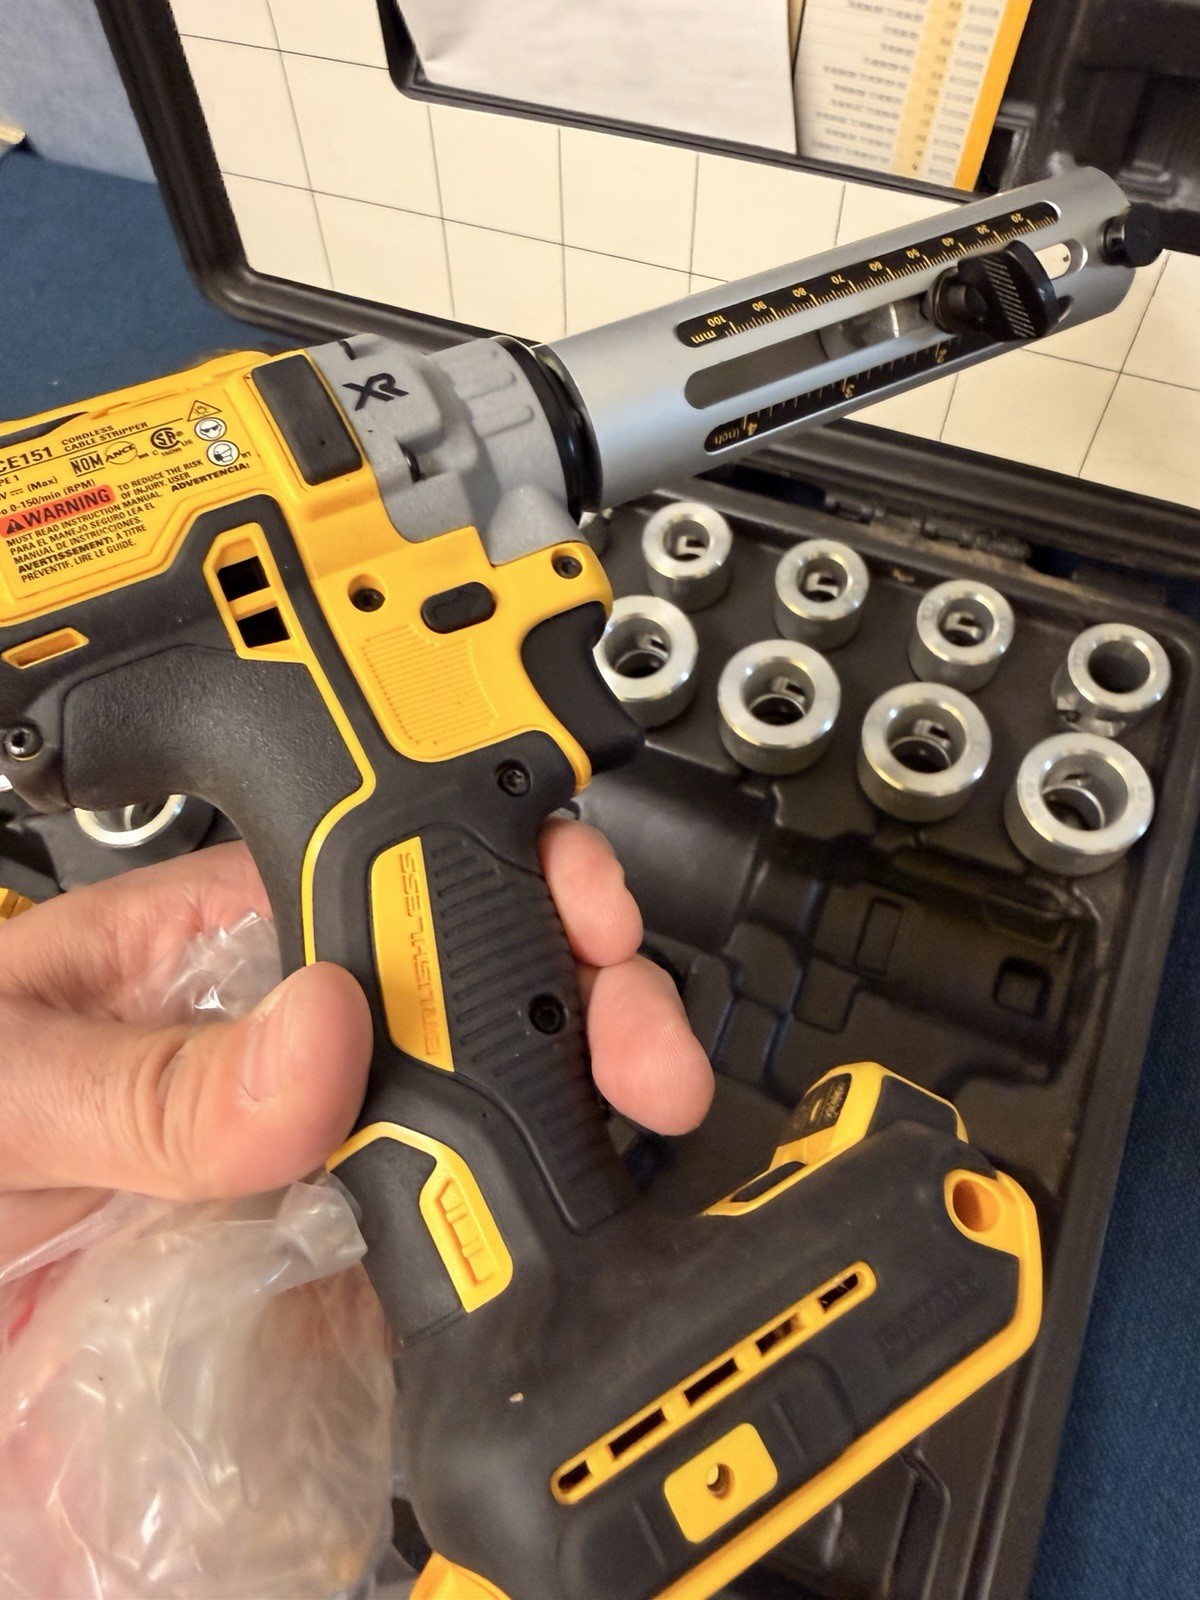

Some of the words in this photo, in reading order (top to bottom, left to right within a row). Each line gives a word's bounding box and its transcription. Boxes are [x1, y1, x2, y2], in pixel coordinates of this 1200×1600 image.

[831, 274, 846, 285] 70
[792, 287, 807, 298] 80
[752, 300, 768, 312] 90
[707, 315, 727, 327] 100
[690, 329, 717, 344] mm
[342, 372, 409, 411] XR
[61, 425, 114, 446] CORDLESS
[64, 439, 96, 452] CABLE
[99, 421, 149, 441] STRIPPER
[70, 453, 104, 474] NOM
[27, 475, 58, 492] (Max)
[117, 482, 130, 492] TO
[130, 472, 165, 488] REDUCE
[165, 465, 184, 476] THE
[183, 459, 204, 470] RISK
[121, 490, 132, 500] OF
[167, 471, 191, 484] USER
[171, 462, 250, 492] ADVERTENCIA:
[10, 491, 62, 512] 0-150/min
[63, 478, 96, 496] (RPM)
[21, 488, 111, 527] WARNING
[6, 532, 33, 547] MUST
[34, 524, 60, 538] READ
[60, 503, 121, 529] INSTRUCTION
[10, 541, 36, 555] PARA
[36, 538, 49, 547] EL
[48, 524, 88, 543] MANEJO
[90, 511, 126, 529] SEGURO
[126, 506, 144, 516] LEA
[144, 502, 156, 511] EL
[122, 524, 147, 537] TITRE
[13, 546, 55, 565] MANUAL
[55, 542, 69, 550] DE
[74, 551, 94, 565] LIRE
[94, 549, 106, 558] LE
[398, 851, 442, 1057] BRUSHLESS
